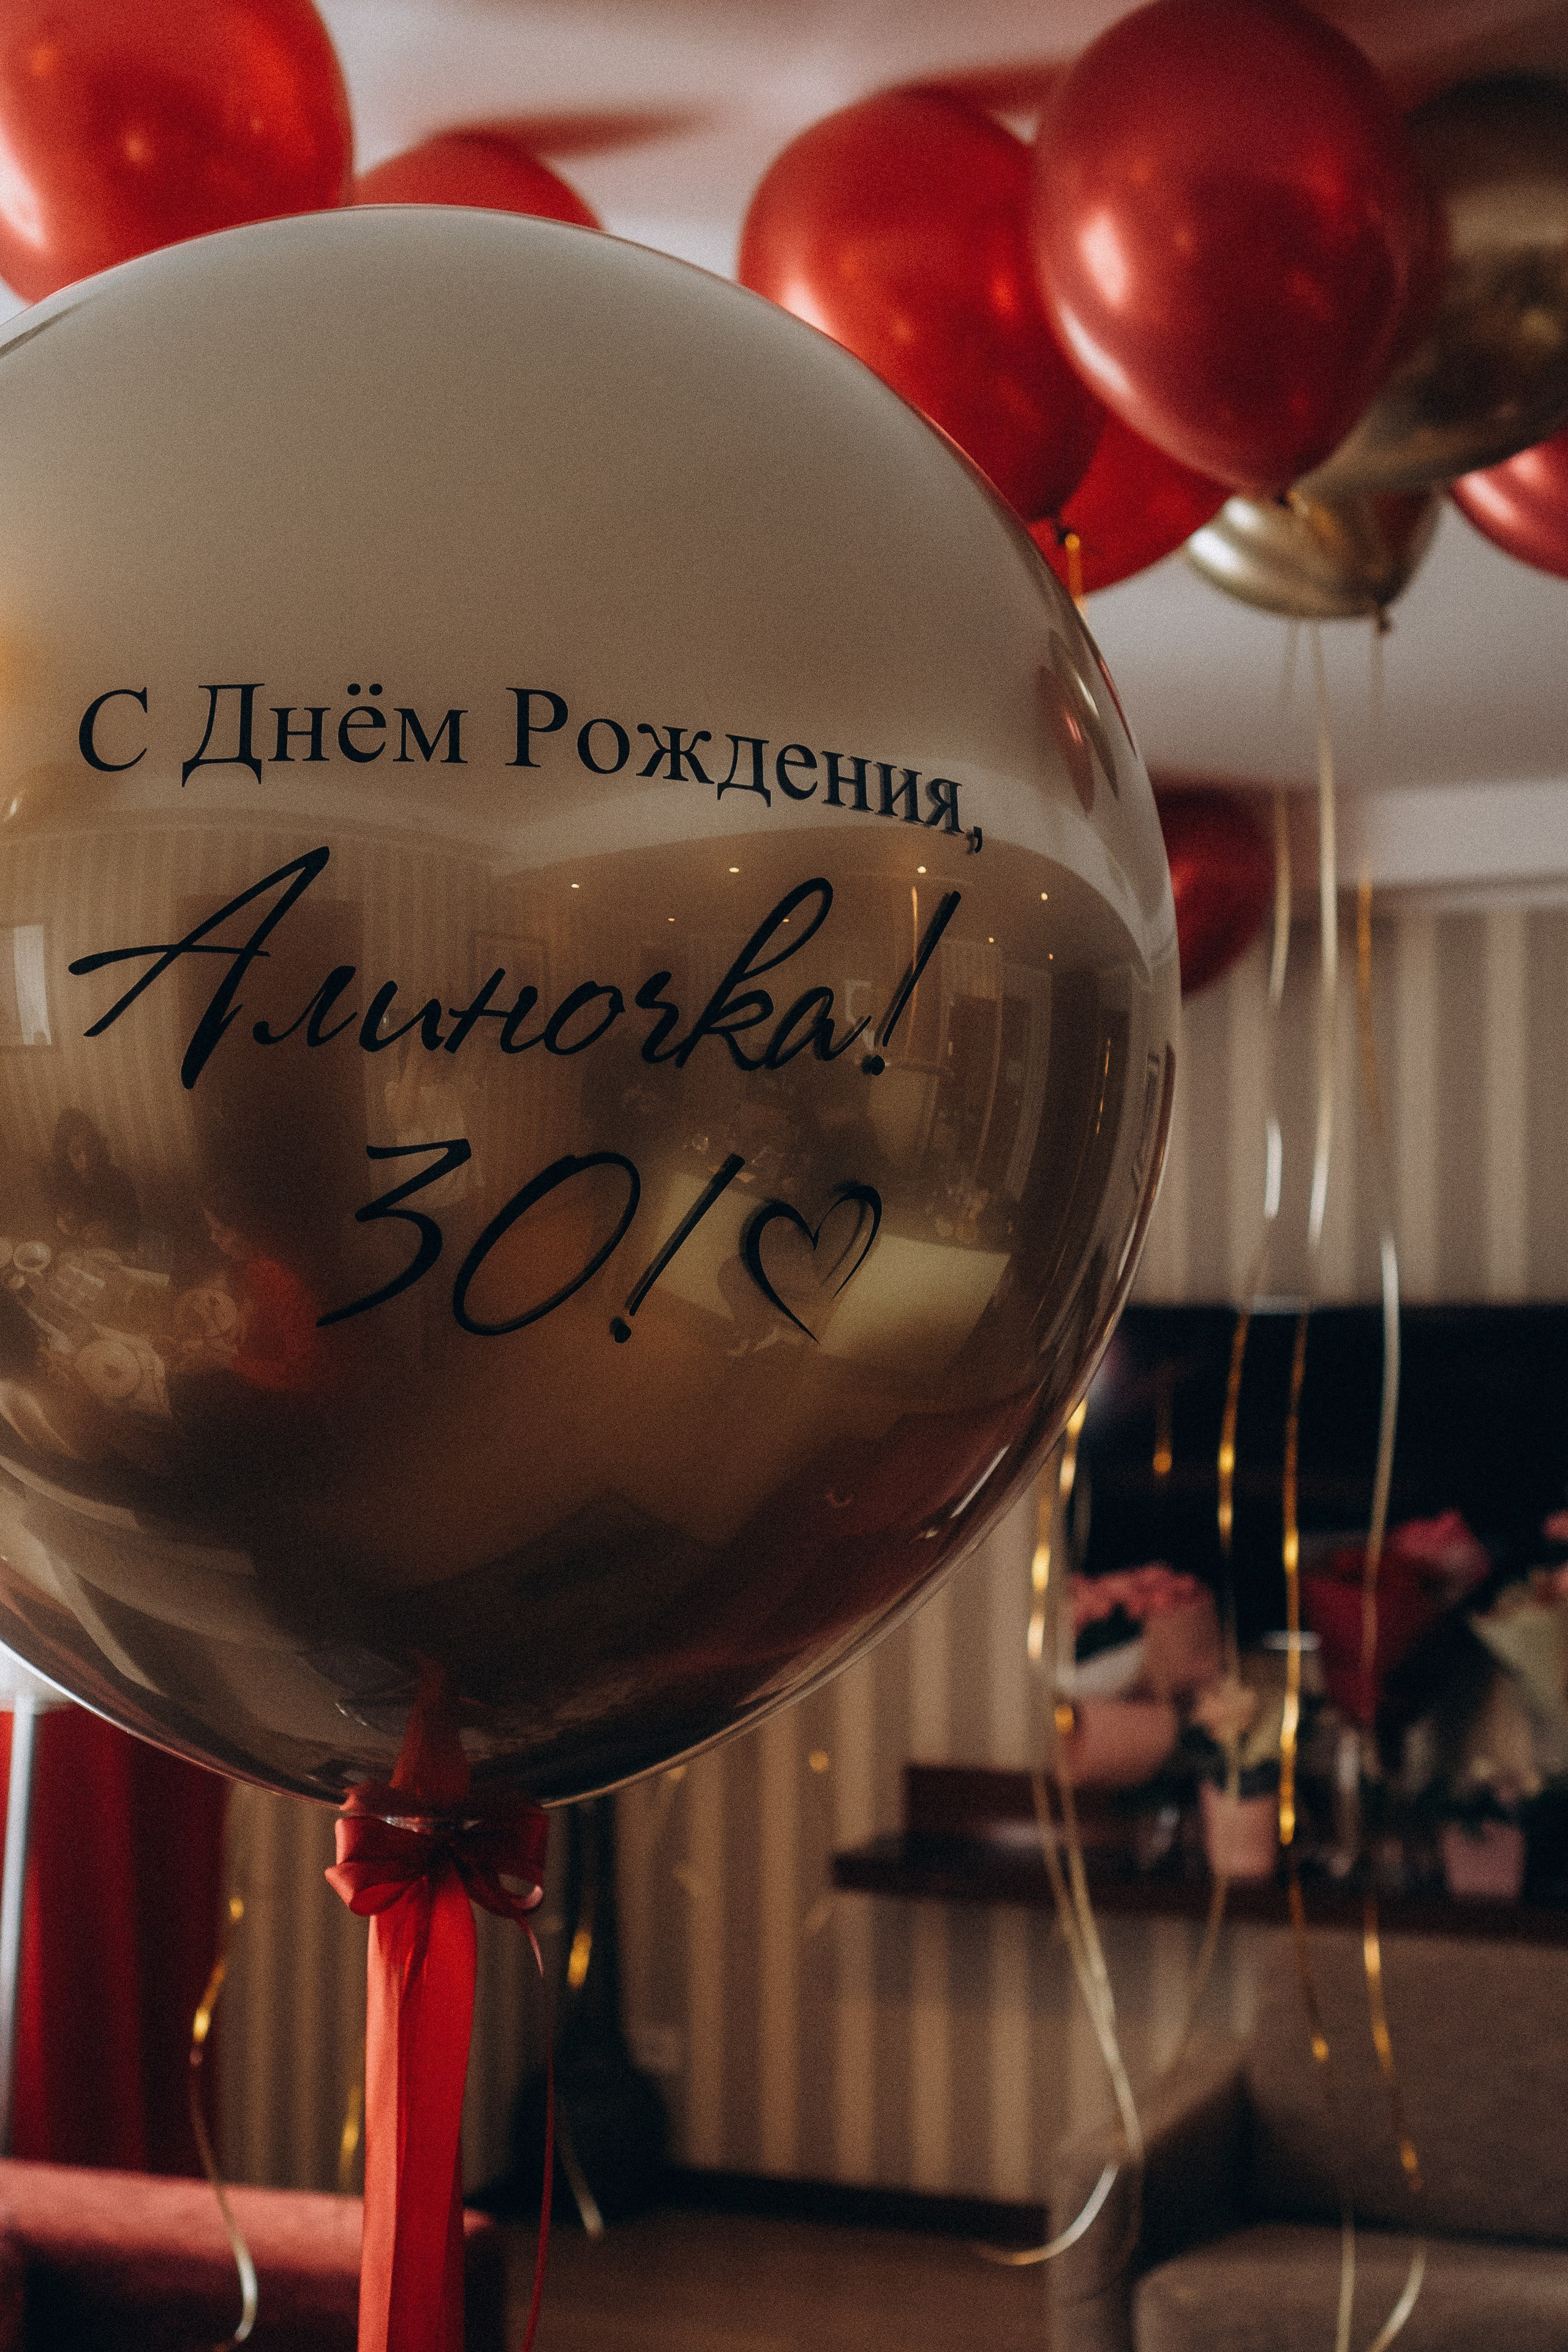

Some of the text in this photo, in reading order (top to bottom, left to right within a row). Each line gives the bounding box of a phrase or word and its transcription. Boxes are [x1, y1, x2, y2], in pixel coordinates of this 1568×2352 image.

[78, 683, 983, 854] С Днём Рождения,
[68, 846, 962, 1090] Алиночка!
[316, 1138, 745, 1343] 30!
